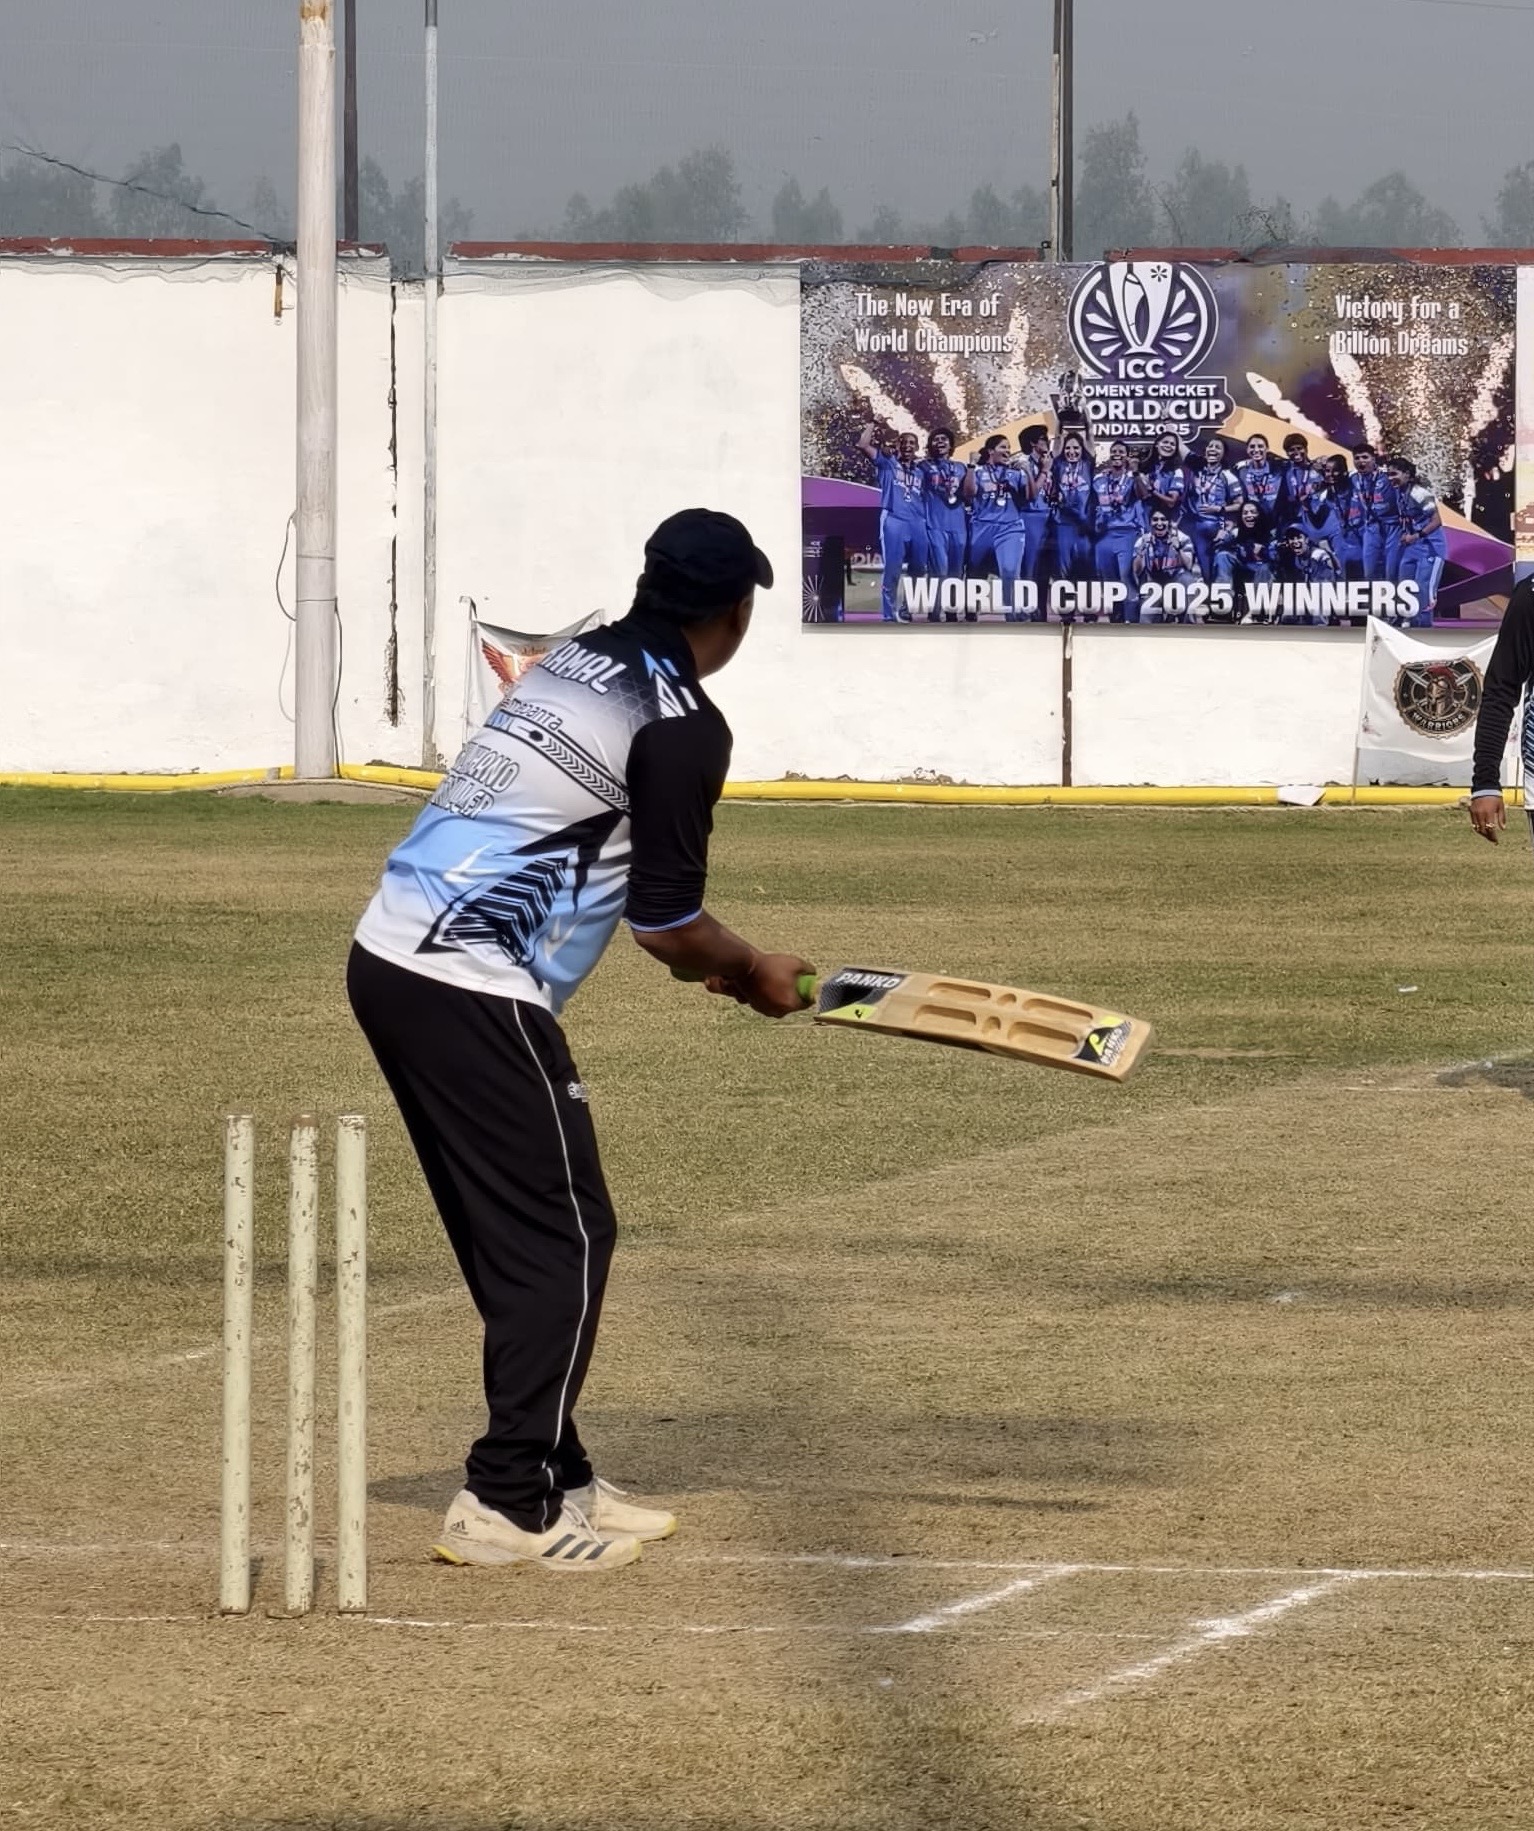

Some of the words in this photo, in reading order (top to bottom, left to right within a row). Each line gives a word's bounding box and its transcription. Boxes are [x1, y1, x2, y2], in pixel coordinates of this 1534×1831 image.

[854, 292, 888, 316] The
[895, 292, 934, 316] New
[940, 292, 972, 316] Era
[979, 292, 1001, 316] of
[1335, 294, 1403, 325] Victory
[1410, 294, 1442, 319] for
[1448, 302, 1460, 319] a
[854, 328, 908, 352] World
[914, 328, 1014, 359] Champions
[1335, 331, 1391, 355] Billion
[1397, 331, 1469, 355] Dreams
[1118, 358, 1166, 379] ICC
[1083, 384, 1145, 397] OMEN'S
[1147, 384, 1216, 397] CRICKET
[1088, 399, 1161, 421] ORLD
[1169, 399, 1226, 420] CUP
[1093, 423, 1142, 436] INDIA
[902, 576, 1039, 615] WORLD
[1049, 579, 1128, 615] CUP
[1138, 582, 1234, 616] 2025
[1245, 579, 1420, 618] WINNERS
